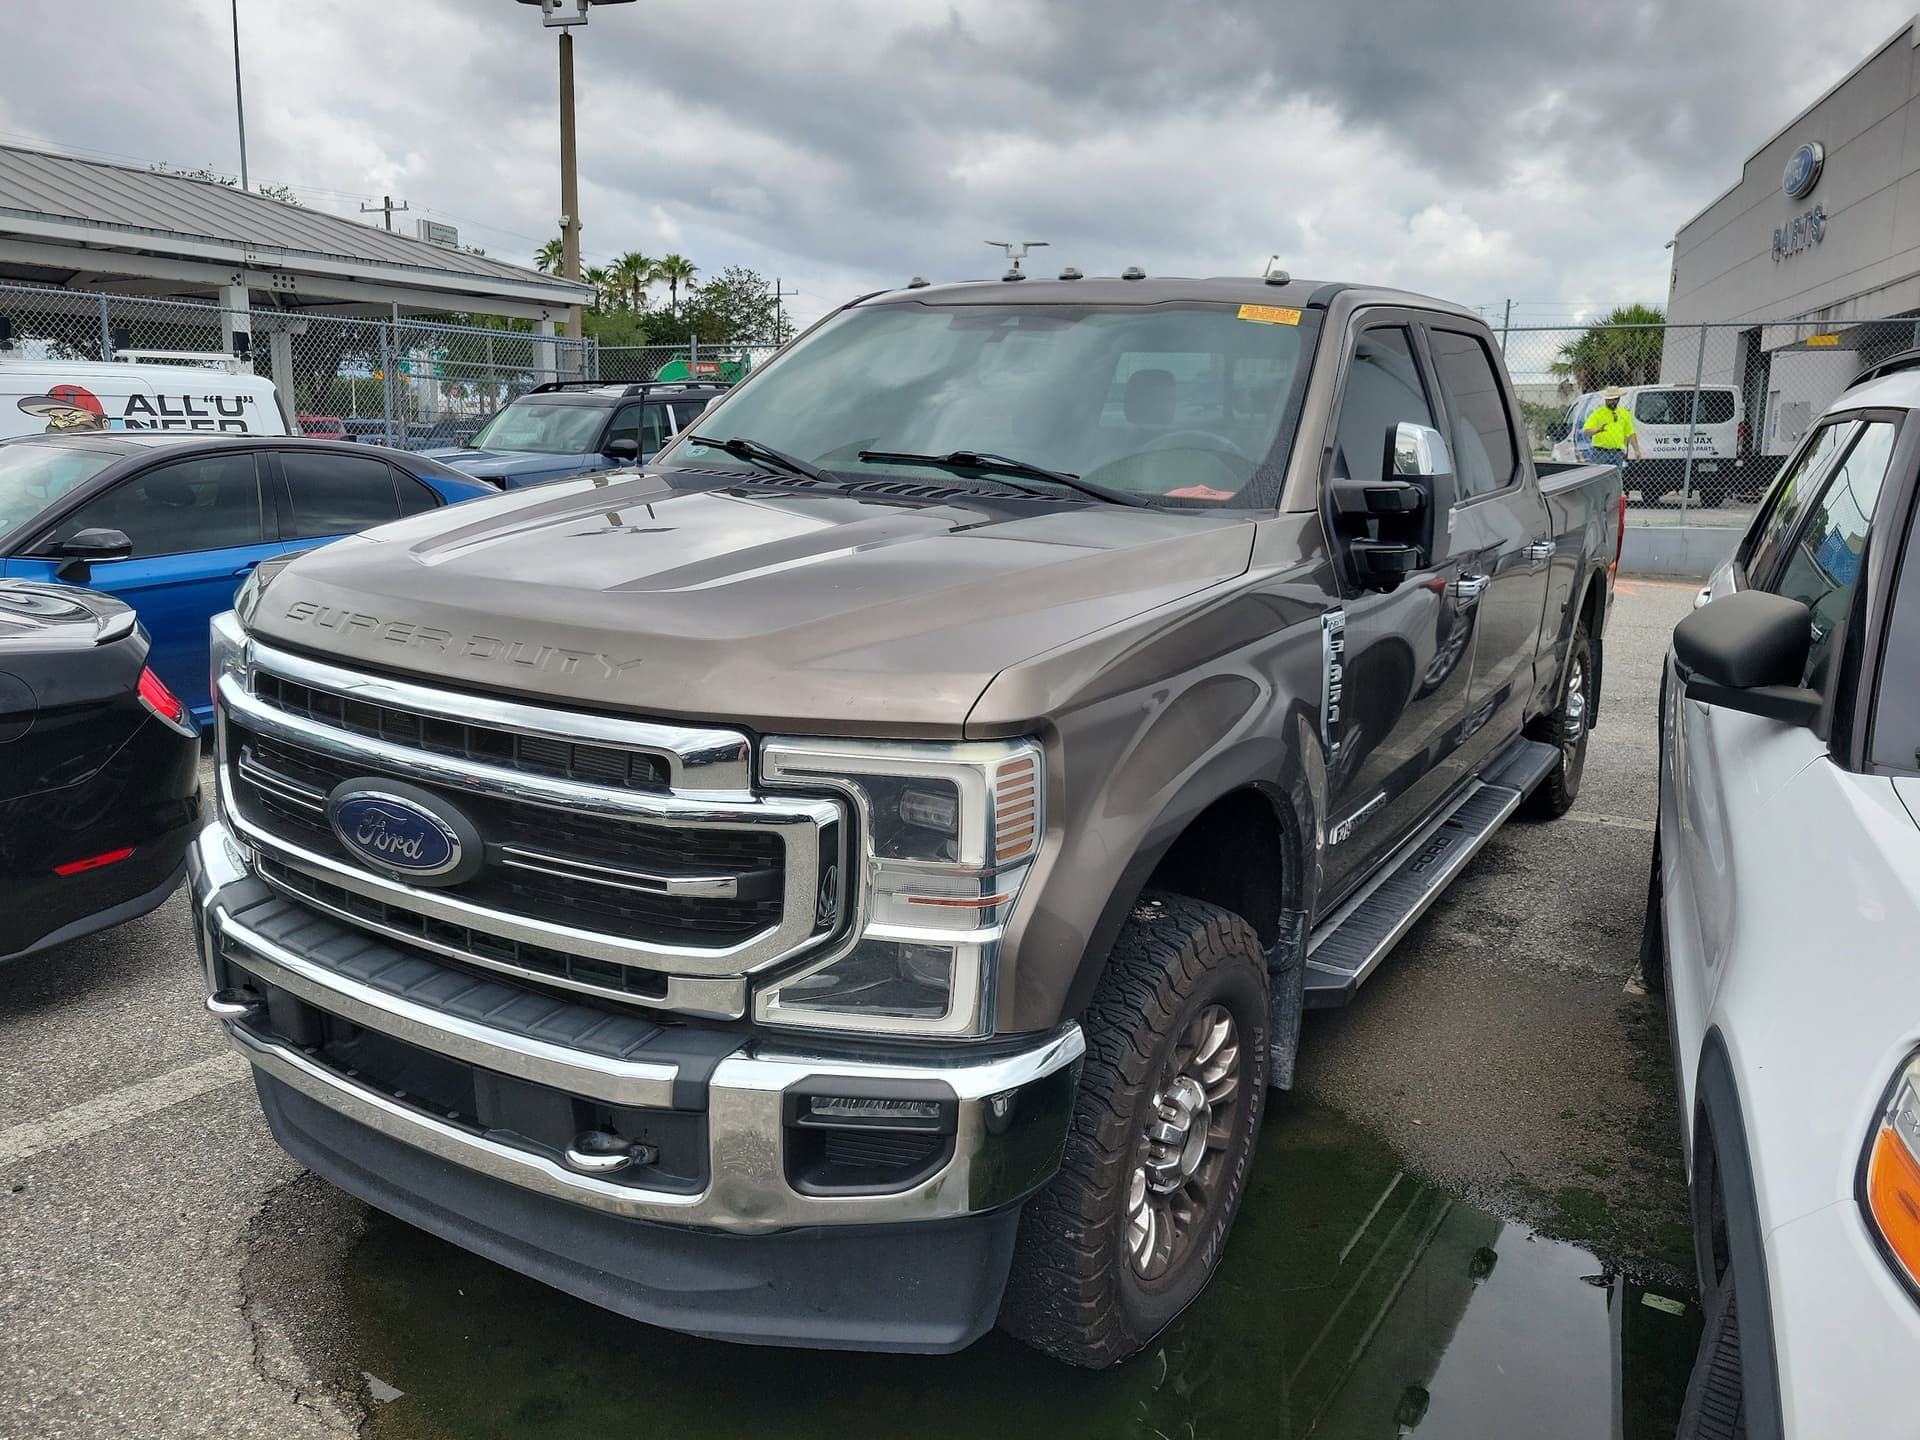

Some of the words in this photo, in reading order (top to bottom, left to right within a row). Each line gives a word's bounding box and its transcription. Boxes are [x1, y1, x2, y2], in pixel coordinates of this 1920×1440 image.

[1772, 204, 1826, 261] PARTS
[124, 394, 208, 416] ALL
[284, 600, 454, 655] SUPER
[460, 633, 644, 681] DUTY
[356, 807, 425, 860] Ford
[1409, 836, 1453, 873] FORD
